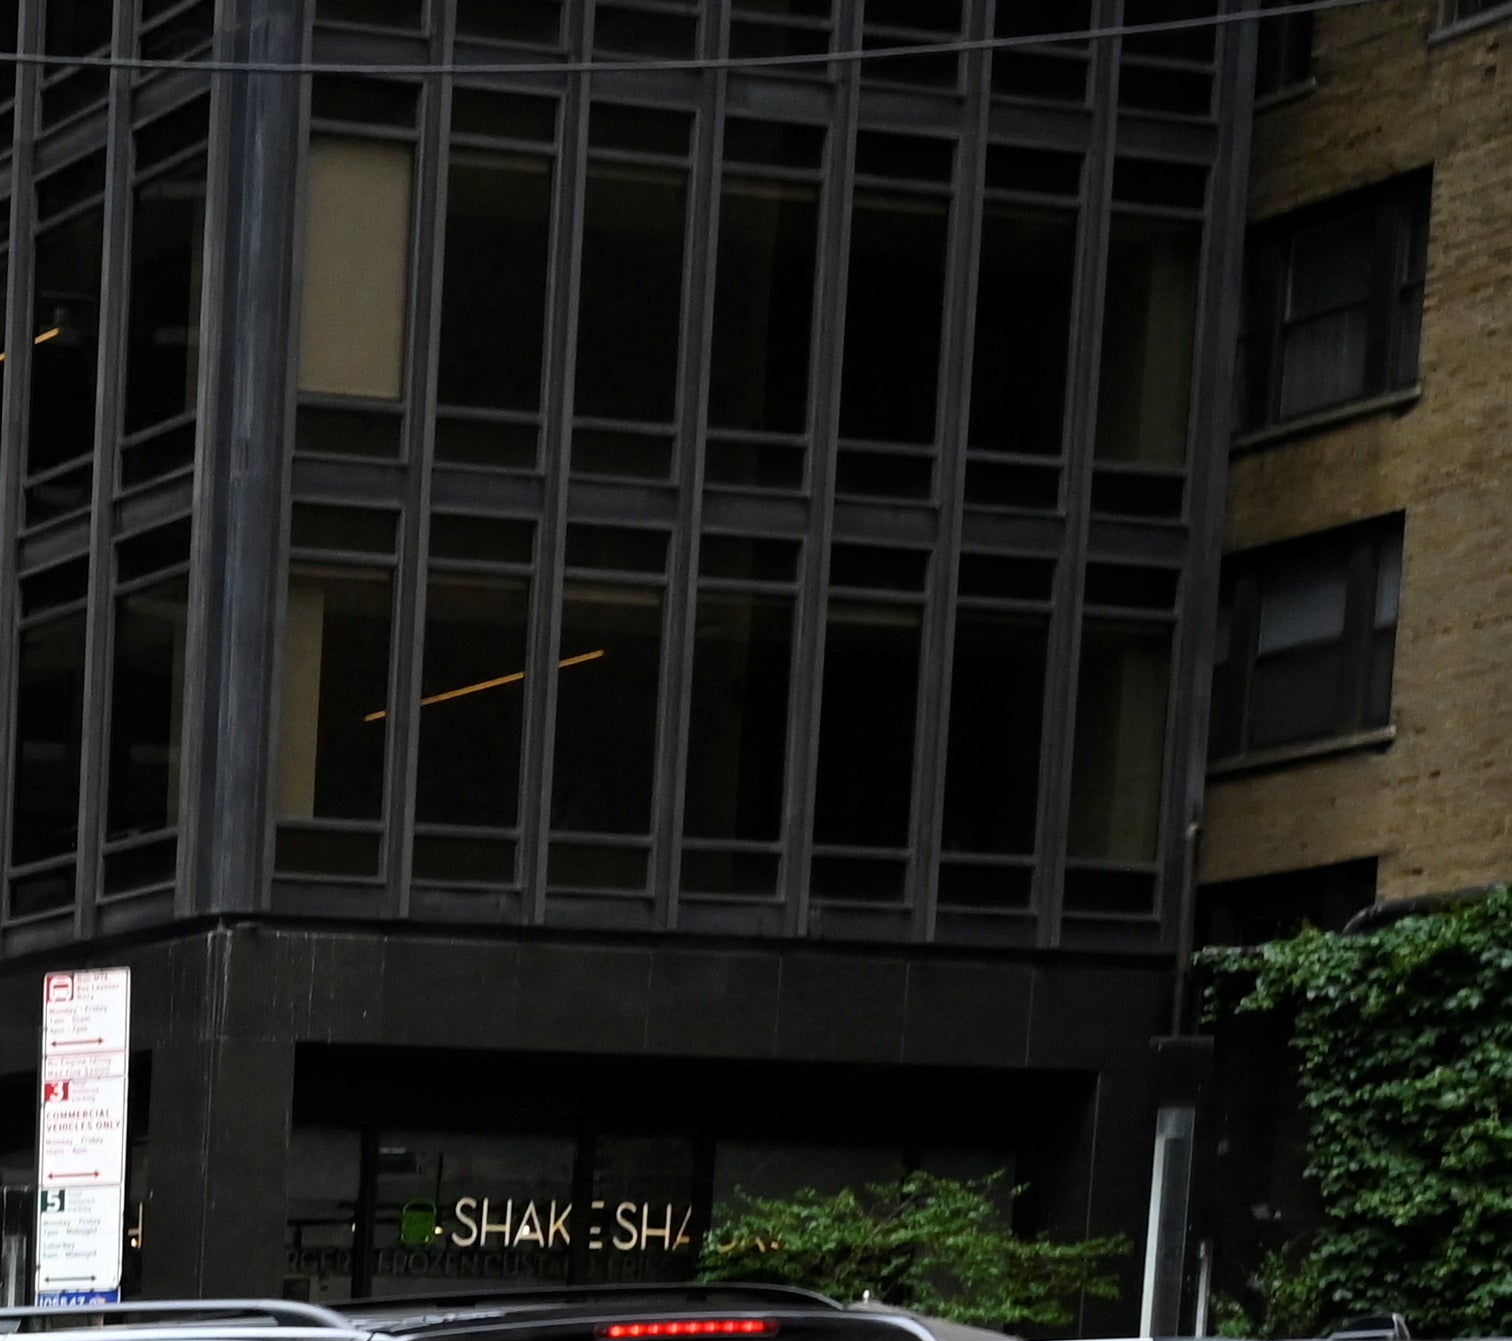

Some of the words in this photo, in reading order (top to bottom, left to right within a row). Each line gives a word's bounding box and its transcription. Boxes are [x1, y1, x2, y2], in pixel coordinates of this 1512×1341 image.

[46, 1108, 109, 1120] COMMERCIAL
[46, 1122, 93, 1133] VEHICLES
[95, 1120, 121, 1130] ONLY
[46, 1189, 61, 1213] 5
